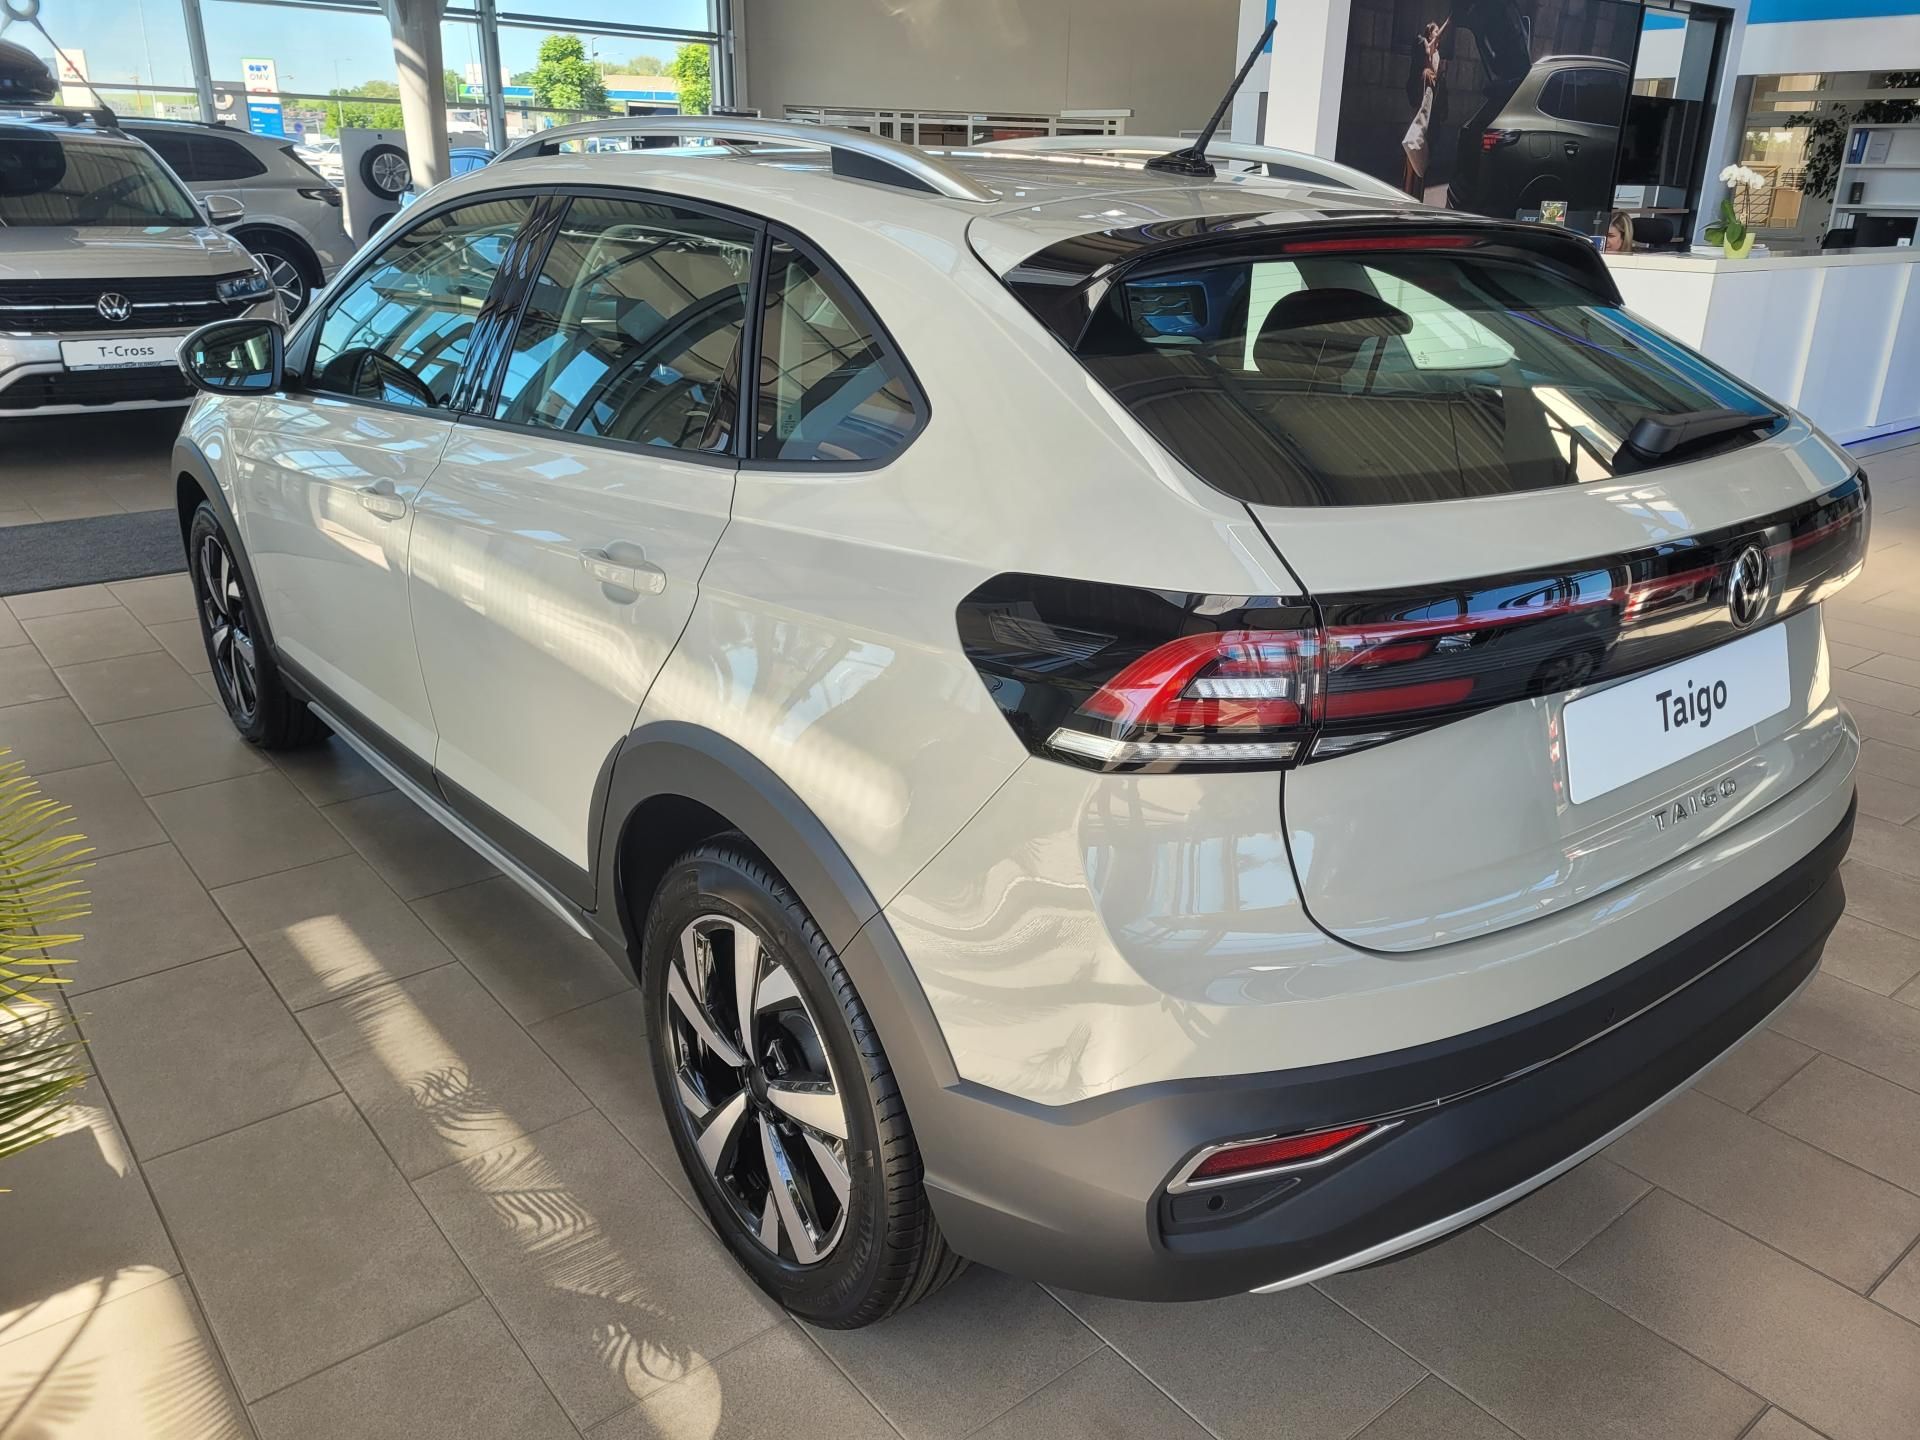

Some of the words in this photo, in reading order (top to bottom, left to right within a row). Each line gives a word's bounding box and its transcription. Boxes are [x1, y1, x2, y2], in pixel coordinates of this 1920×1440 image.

[97, 345, 155, 358] T-Cross
[1655, 679, 1728, 733] Taigo
[1651, 776, 1738, 832] TAIGO
